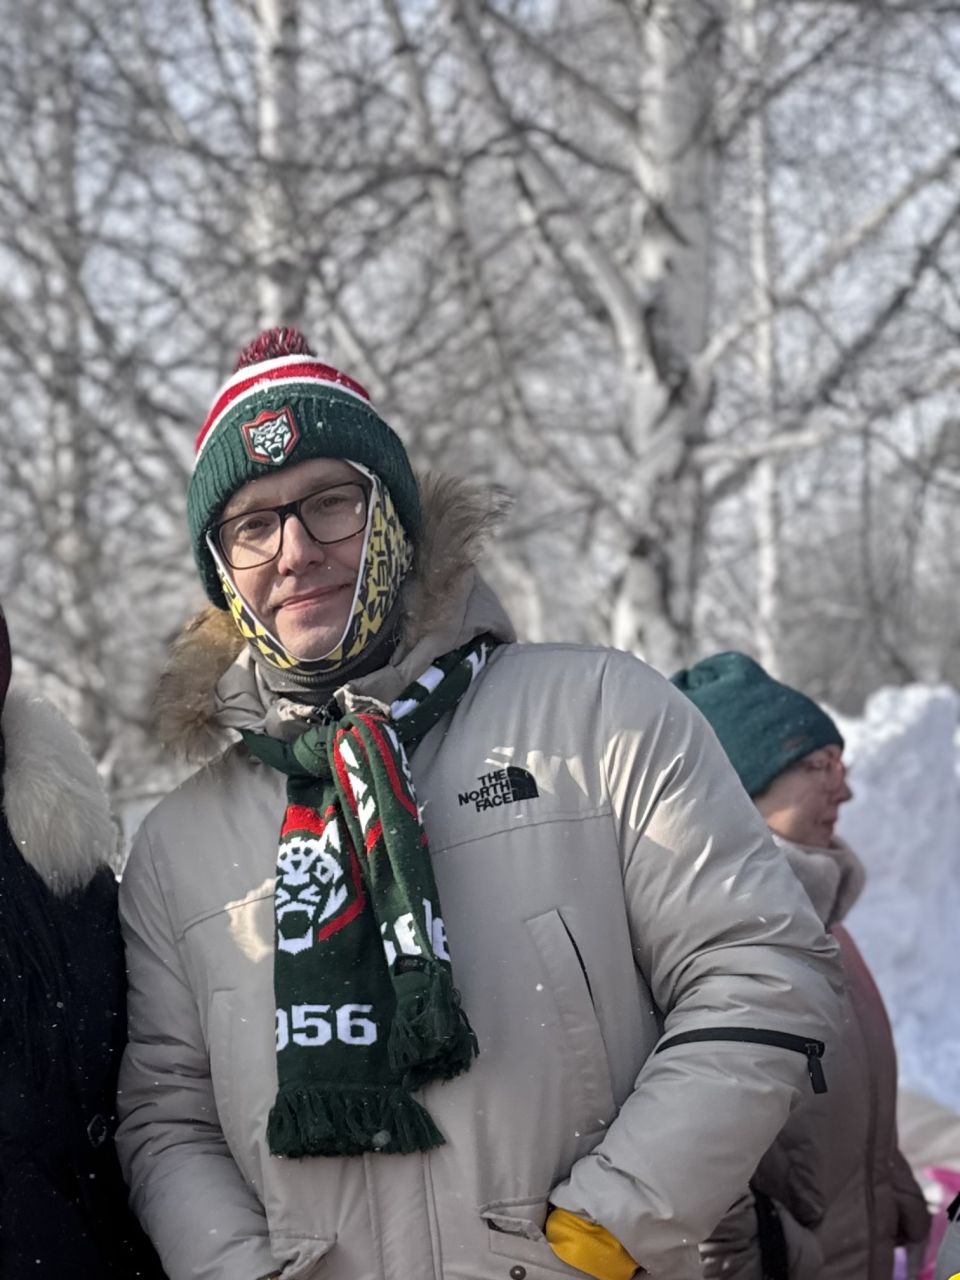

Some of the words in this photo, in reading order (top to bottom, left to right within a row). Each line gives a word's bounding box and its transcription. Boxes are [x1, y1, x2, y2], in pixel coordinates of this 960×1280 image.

[477, 769, 507, 786] THE
[458, 780, 511, 806] NORTH
[475, 792, 513, 812] FACE
